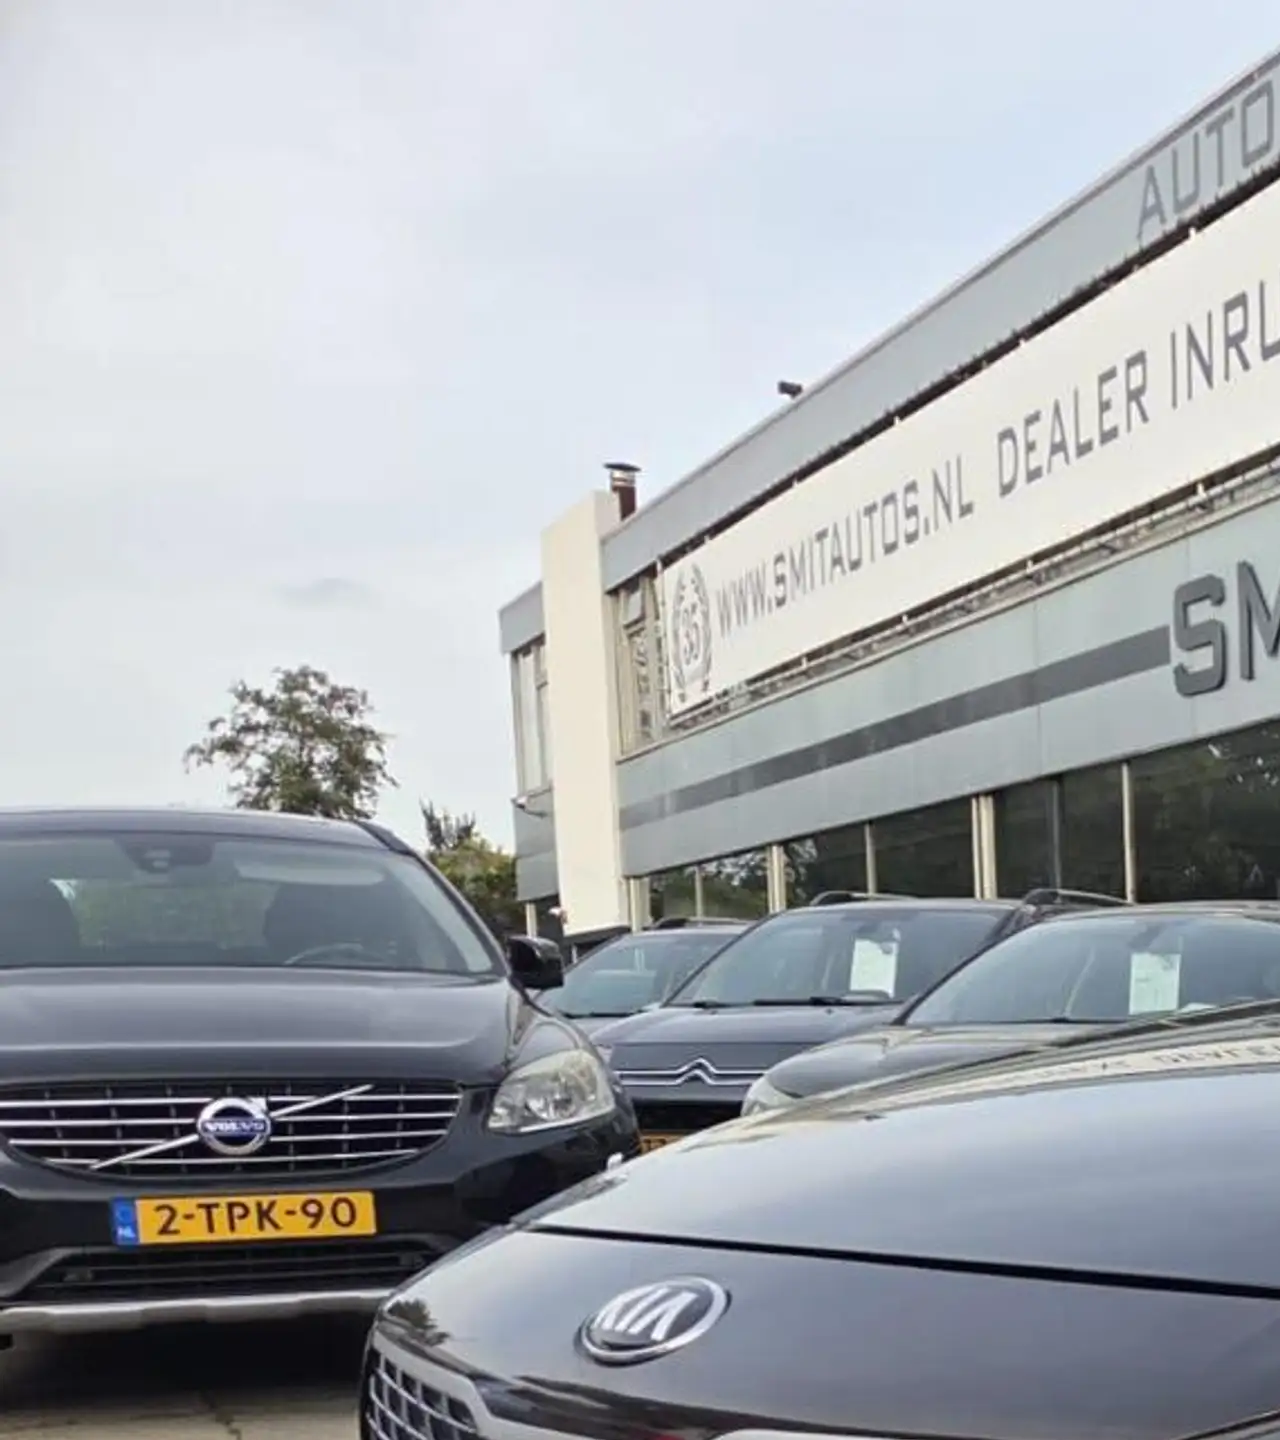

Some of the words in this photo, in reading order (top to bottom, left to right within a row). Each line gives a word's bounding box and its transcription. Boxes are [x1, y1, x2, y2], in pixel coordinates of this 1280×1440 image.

[716, 453, 974, 638] WWW.SMITAUTOS.NL
[997, 350, 1149, 497] DEALER
[153, 1197, 357, 1235] 2-TPK-90
